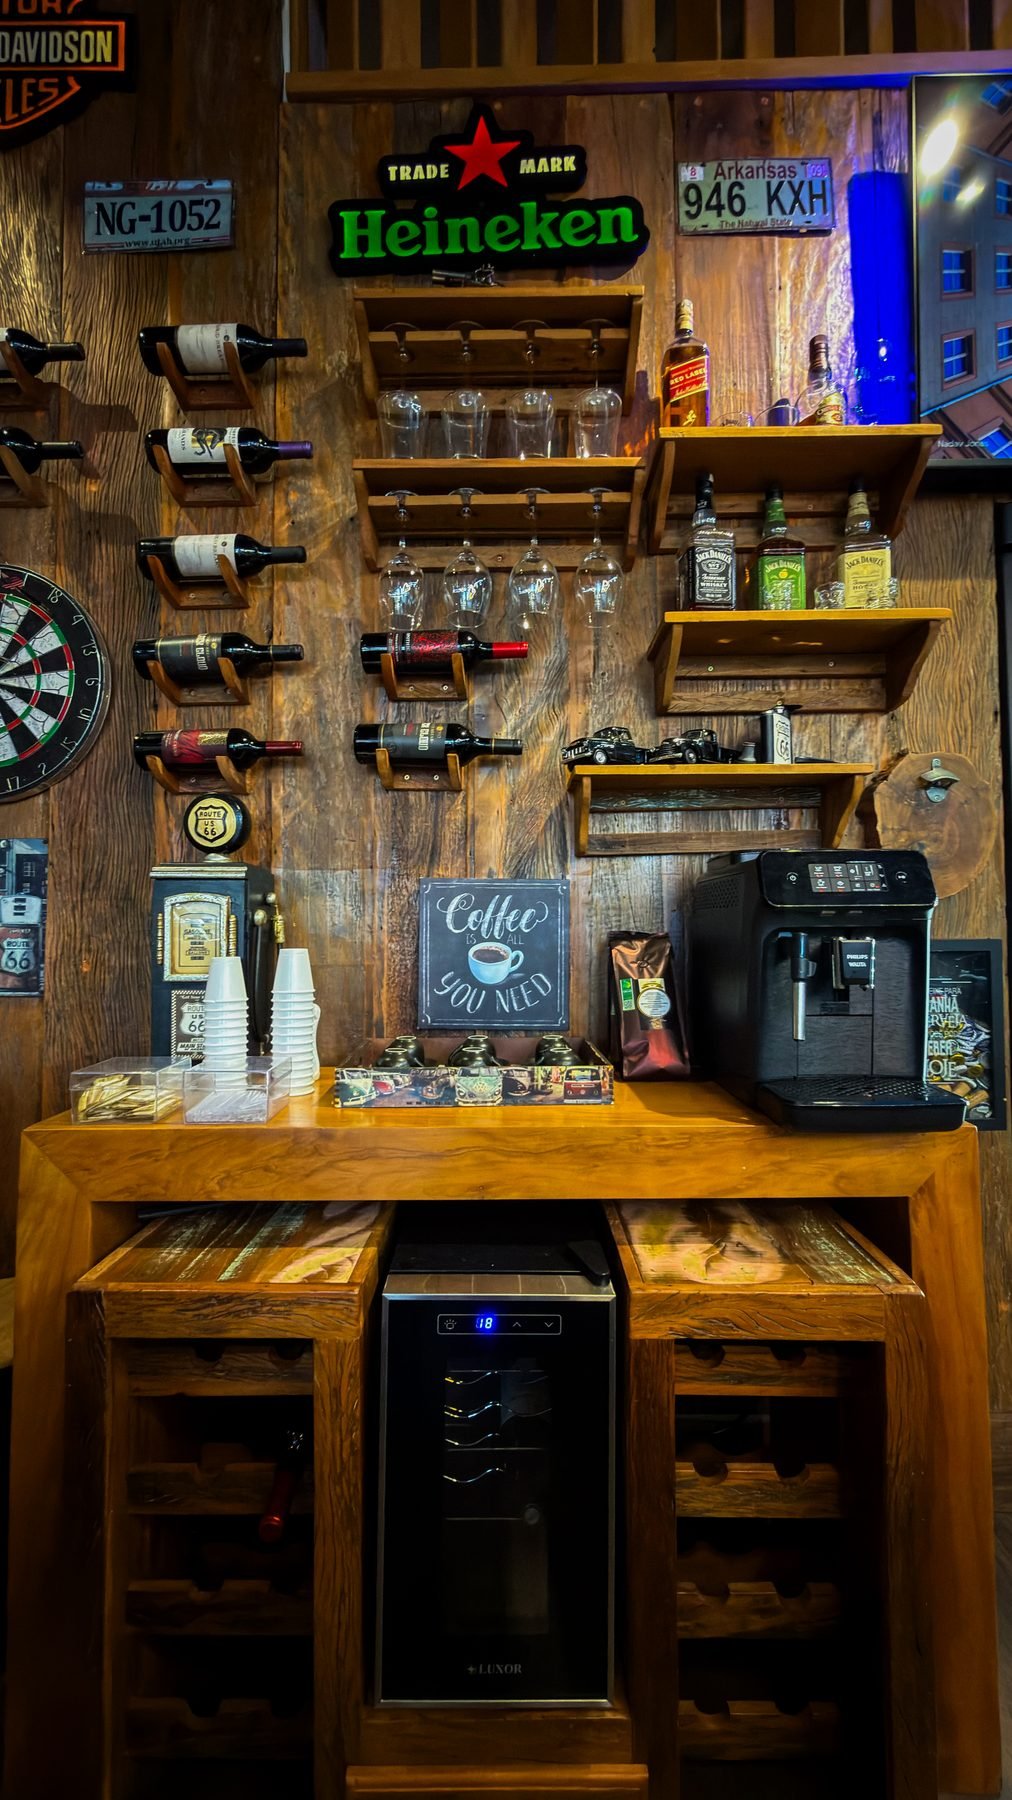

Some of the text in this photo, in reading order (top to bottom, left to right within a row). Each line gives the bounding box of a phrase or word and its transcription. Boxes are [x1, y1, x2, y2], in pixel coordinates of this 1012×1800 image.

[388, 155, 576, 181] TRADE MARK
[714, 162, 797, 180] Arkansas
[684, 180, 827, 220] 946 KXH
[95, 200, 221, 235] NG-1052
[340, 201, 639, 259] Heineken
[669, 375, 685, 385] RED
[204, 827, 217, 836] 66
[437, 892, 549, 940] Coffee
[466, 933, 525, 945] IS ALL
[5, 951, 31, 970] 66
[433, 971, 552, 1015] YOU NEED
[927, 1040, 952, 1056] EBER
[479, 1317, 493, 1329] 18
[479, 1663, 523, 1674] LUXOR
